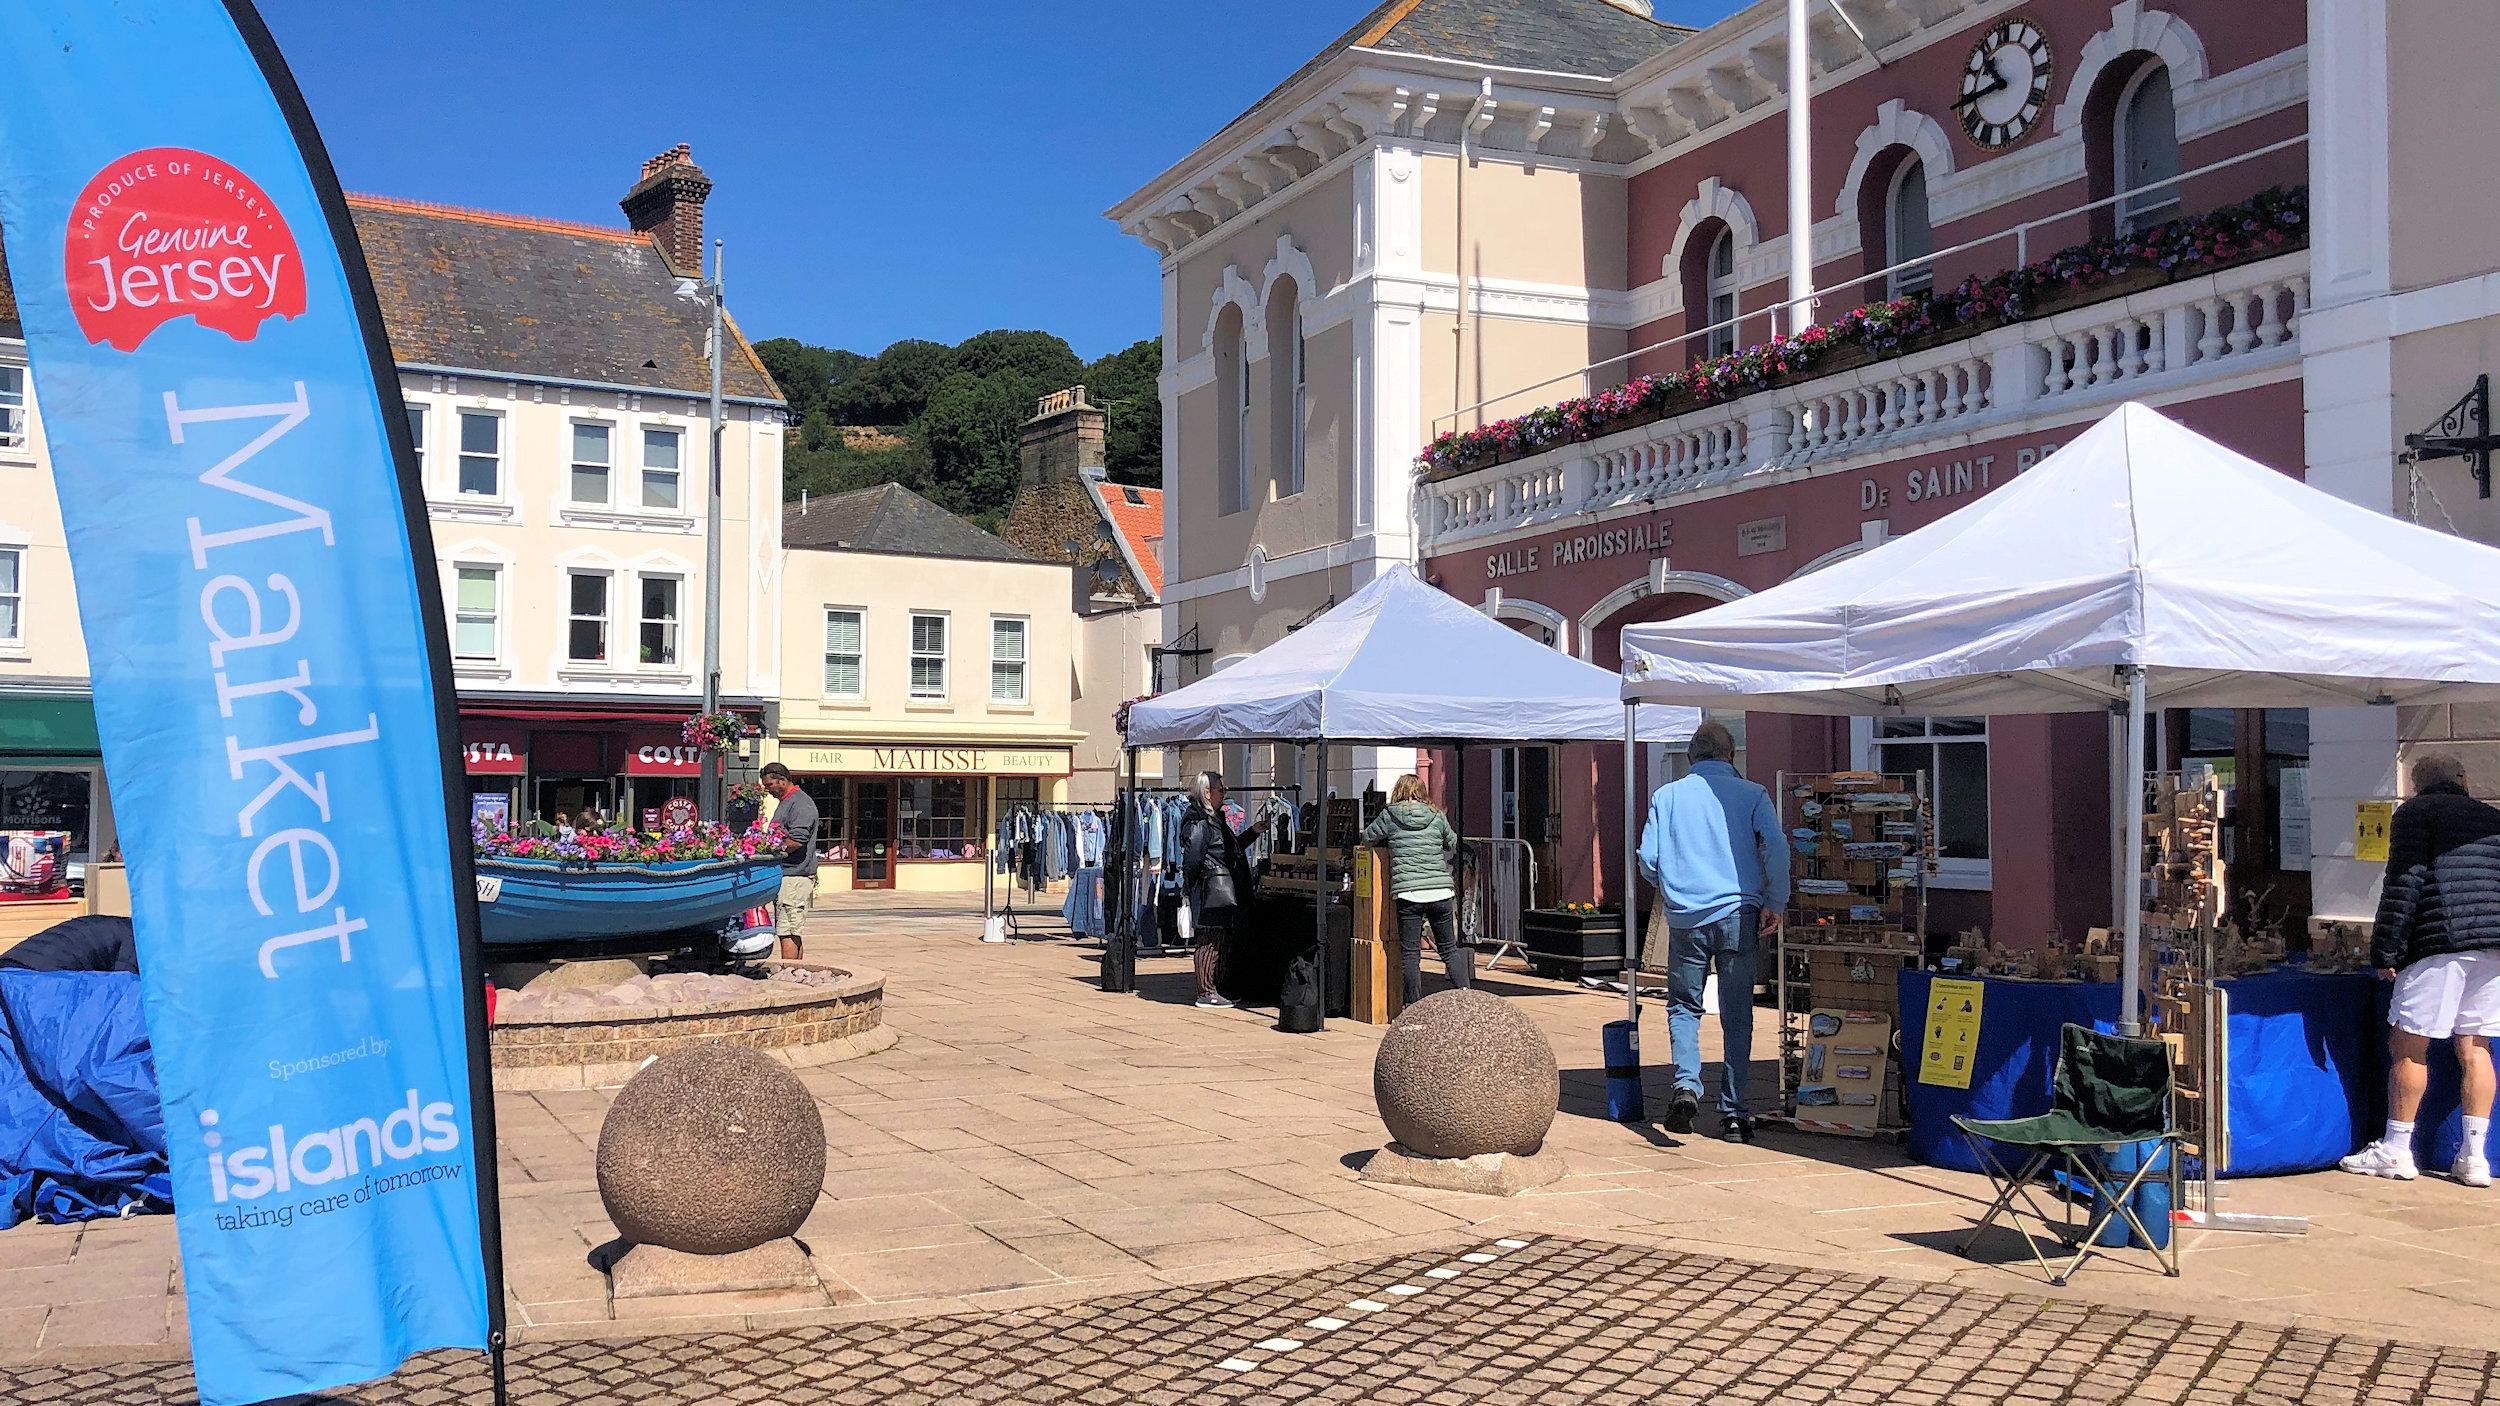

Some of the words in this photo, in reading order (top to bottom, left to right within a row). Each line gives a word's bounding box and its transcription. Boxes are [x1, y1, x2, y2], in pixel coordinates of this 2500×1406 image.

[83, 163, 158, 231] PRODUCE
[167, 161, 193, 175] OF
[203, 168, 268, 221] JERSEY
[118, 211, 253, 259] Genuine
[87, 253, 287, 312] Jersey
[1905, 454, 1995, 502] SAINT
[1486, 545, 1540, 580] SALLE
[1552, 518, 1673, 567] PAROISSIALE
[162, 380, 380, 979] Market
[463, 742, 514, 764] STA
[638, 745, 702, 766] COST
[809, 752, 844, 764] HAIR
[872, 747, 987, 771] MATISSE
[1002, 755, 1053, 767] BEAUTY
[3, 814, 62, 825] Morrisons
[668, 800, 692, 810] COSTA
[268, 1040, 368, 1081] Sponsored
[199, 1088, 459, 1202] islands
[214, 1205, 293, 1231] taking
[299, 1193, 349, 1217] care
[353, 1174, 372, 1204] of
[373, 1163, 463, 1196] tomorrow
